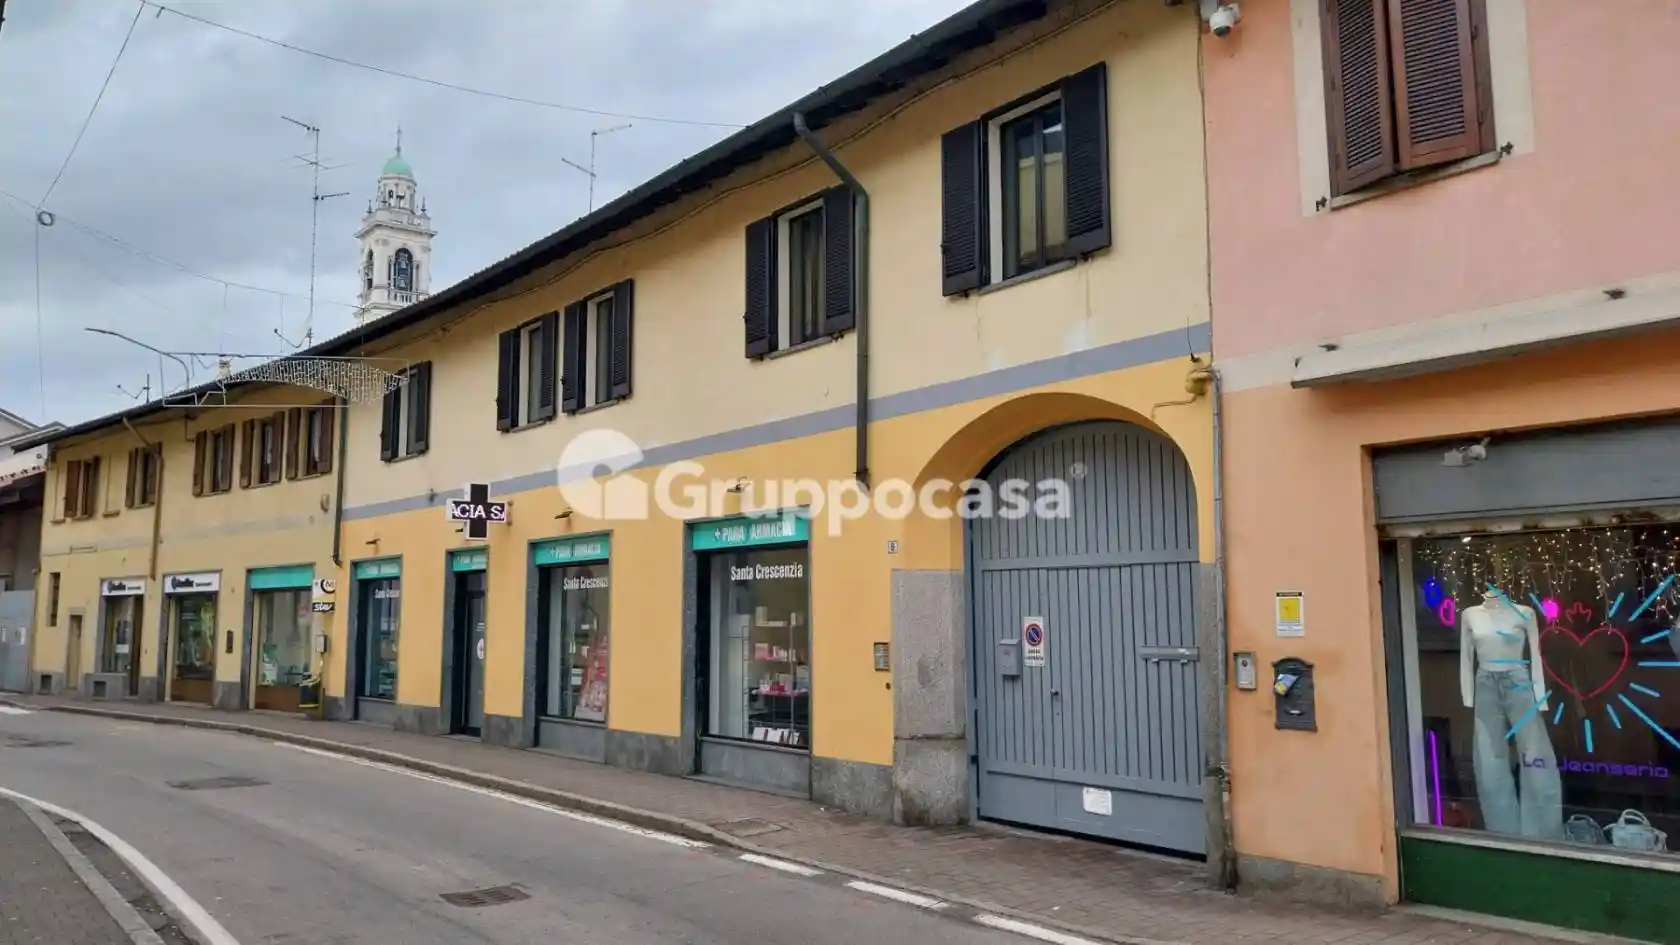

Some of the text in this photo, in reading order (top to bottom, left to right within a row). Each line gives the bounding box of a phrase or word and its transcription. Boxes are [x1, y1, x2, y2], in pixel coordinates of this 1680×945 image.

[491, 505, 505, 519] S
[730, 562, 804, 581] Santa Crescenzia
[1522, 753, 1546, 769] La
